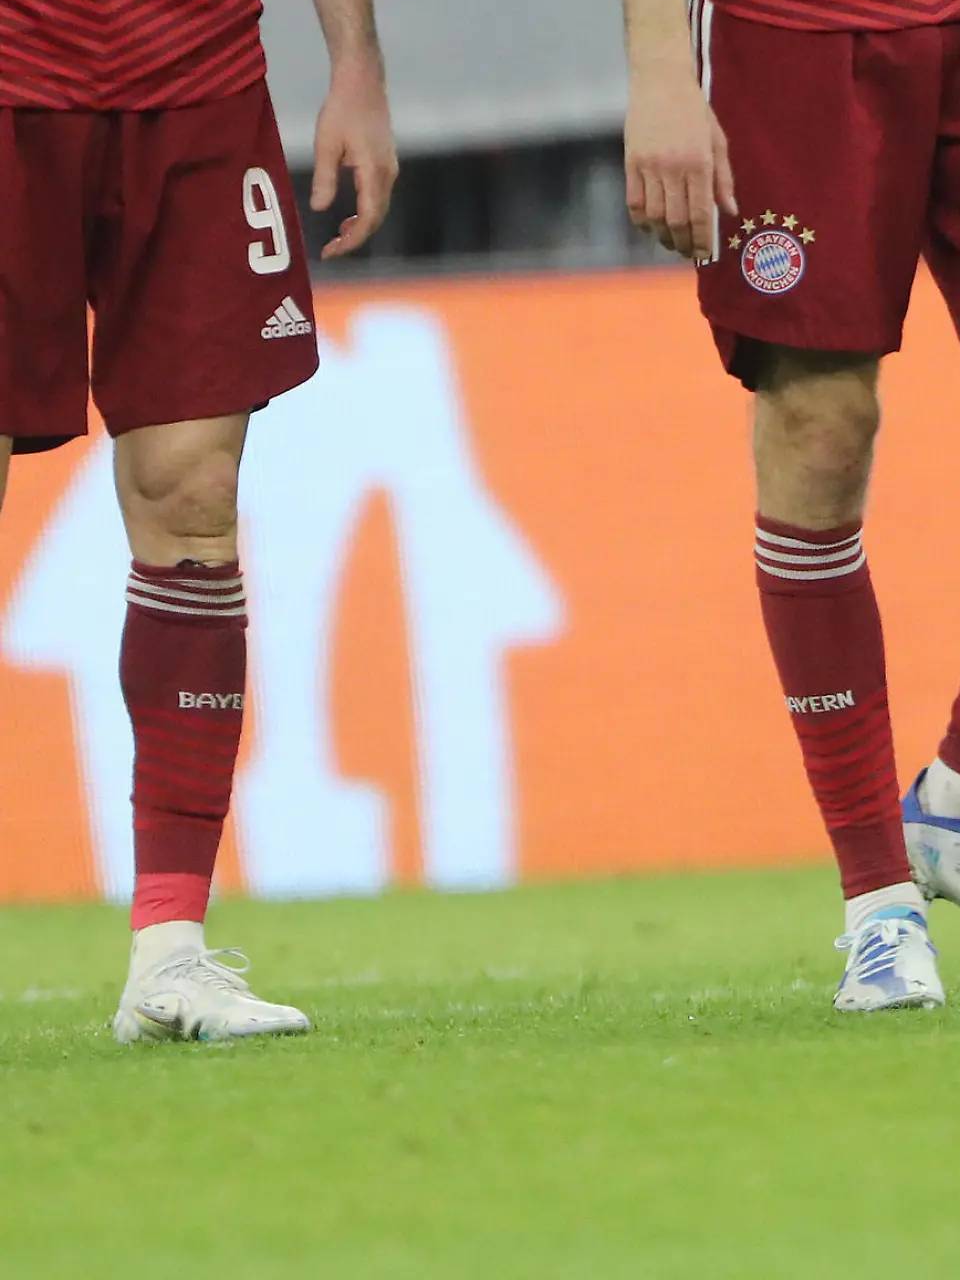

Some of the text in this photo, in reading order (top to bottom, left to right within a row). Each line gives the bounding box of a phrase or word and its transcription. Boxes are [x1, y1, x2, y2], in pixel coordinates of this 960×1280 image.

[242, 166, 291, 275] 9
[756, 234, 798, 257] BAYERN
[261, 320, 313, 340] adidas
[785, 690, 856, 713] AYERN
